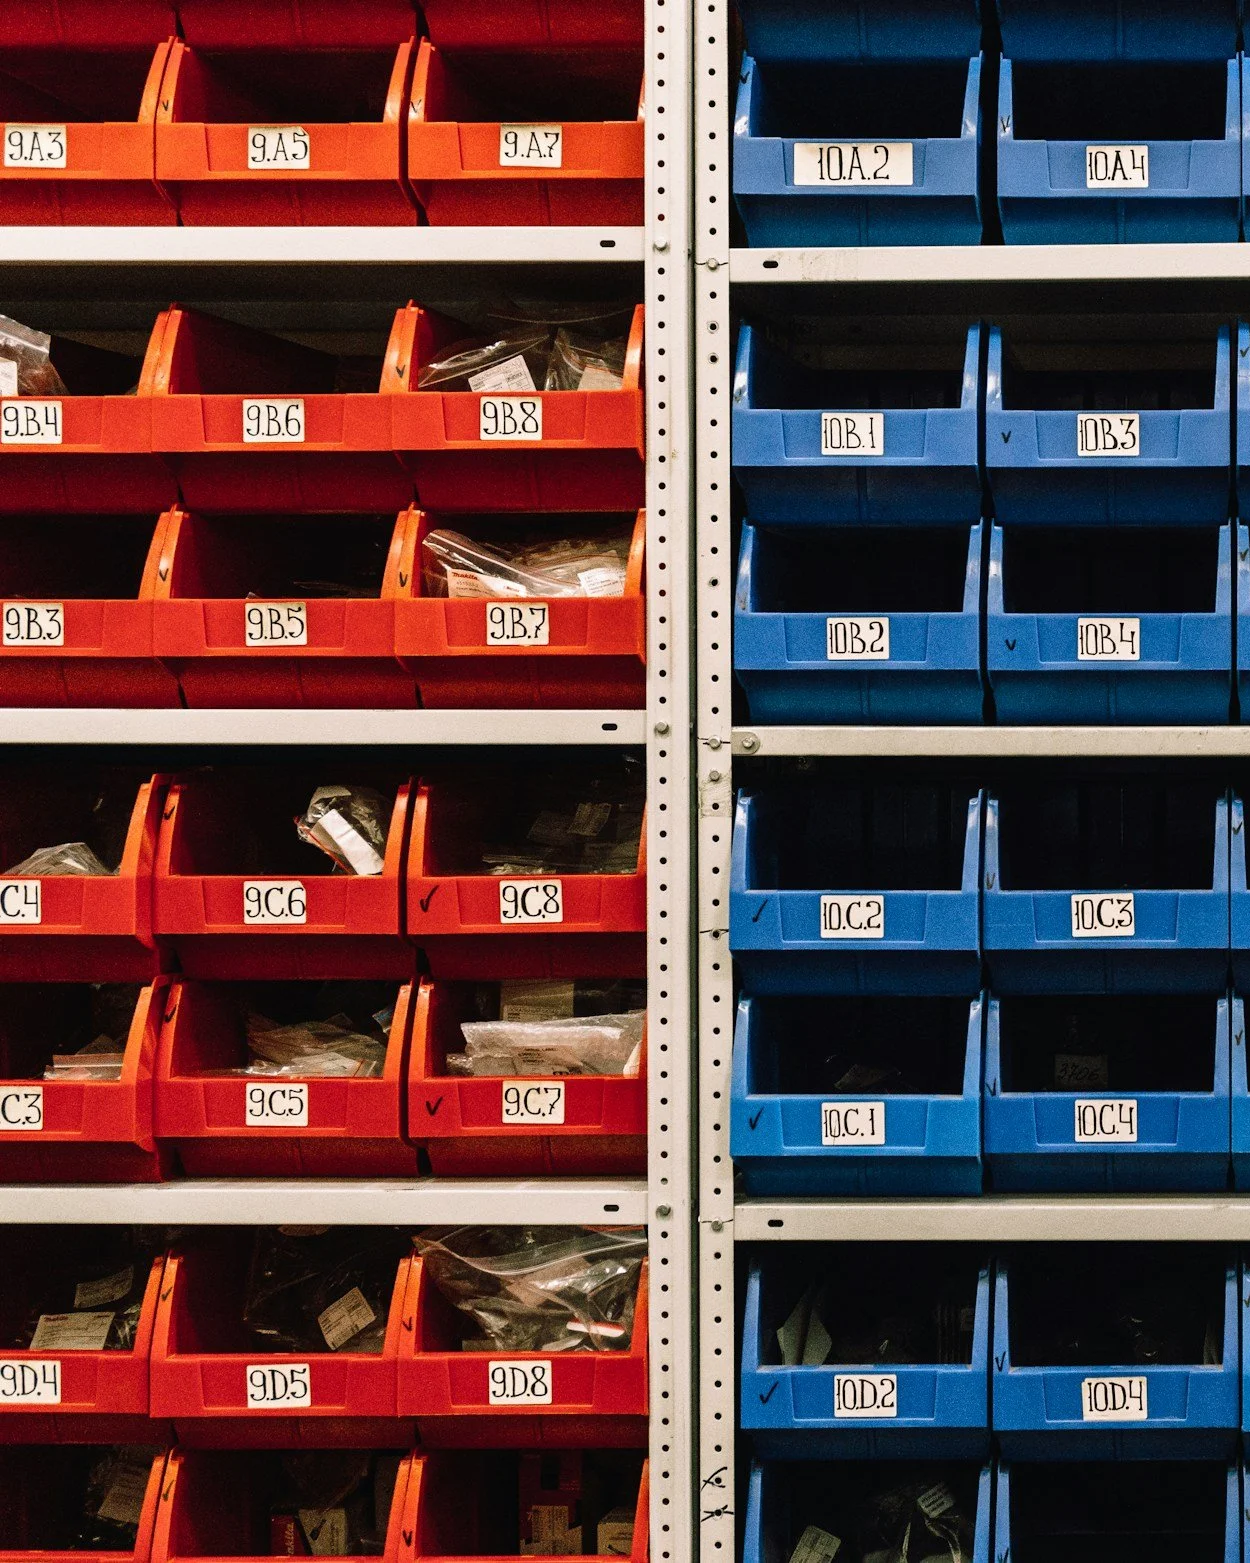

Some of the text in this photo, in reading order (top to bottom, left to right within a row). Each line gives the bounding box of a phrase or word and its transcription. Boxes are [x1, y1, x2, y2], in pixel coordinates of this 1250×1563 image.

[251, 132, 308, 162] 9.A.5
[503, 131, 560, 158] 9.A.7
[817, 146, 889, 181] 10.A.2
[1088, 149, 1146, 181] 10.A.4
[245, 404, 301, 436] 9.B.6
[482, 401, 539, 435] 9.B.8
[823, 418, 876, 449] 10.B.1
[1079, 418, 1136, 450] 10.B.3
[5, 607, 62, 640] 9.B.3
[248, 607, 305, 640] 9.B.5
[489, 606, 546, 640] 9.B.7
[829, 621, 884, 654] 10.B.2
[1080, 622, 1136, 655] 10.B.4
[246, 886, 305, 918] 9.C.6
[823, 901, 882, 931] 10.C.2
[1074, 898, 1133, 930] 10.C.3
[248, 1088, 304, 1116] 9.C.5
[505, 1087, 561, 1117] 9.C.7
[824, 1108, 876, 1138] 10.C.1
[1077, 1103, 1134, 1136] 10.C.4
[0, 1364, 57, 1396] 9.D.4
[249, 1368, 308, 1401] 9.D.5
[491, 1366, 548, 1398] 9.D.8
[836, 1378, 895, 1410] 10.D.2
[1086, 1380, 1143, 1412] 10.D.4
